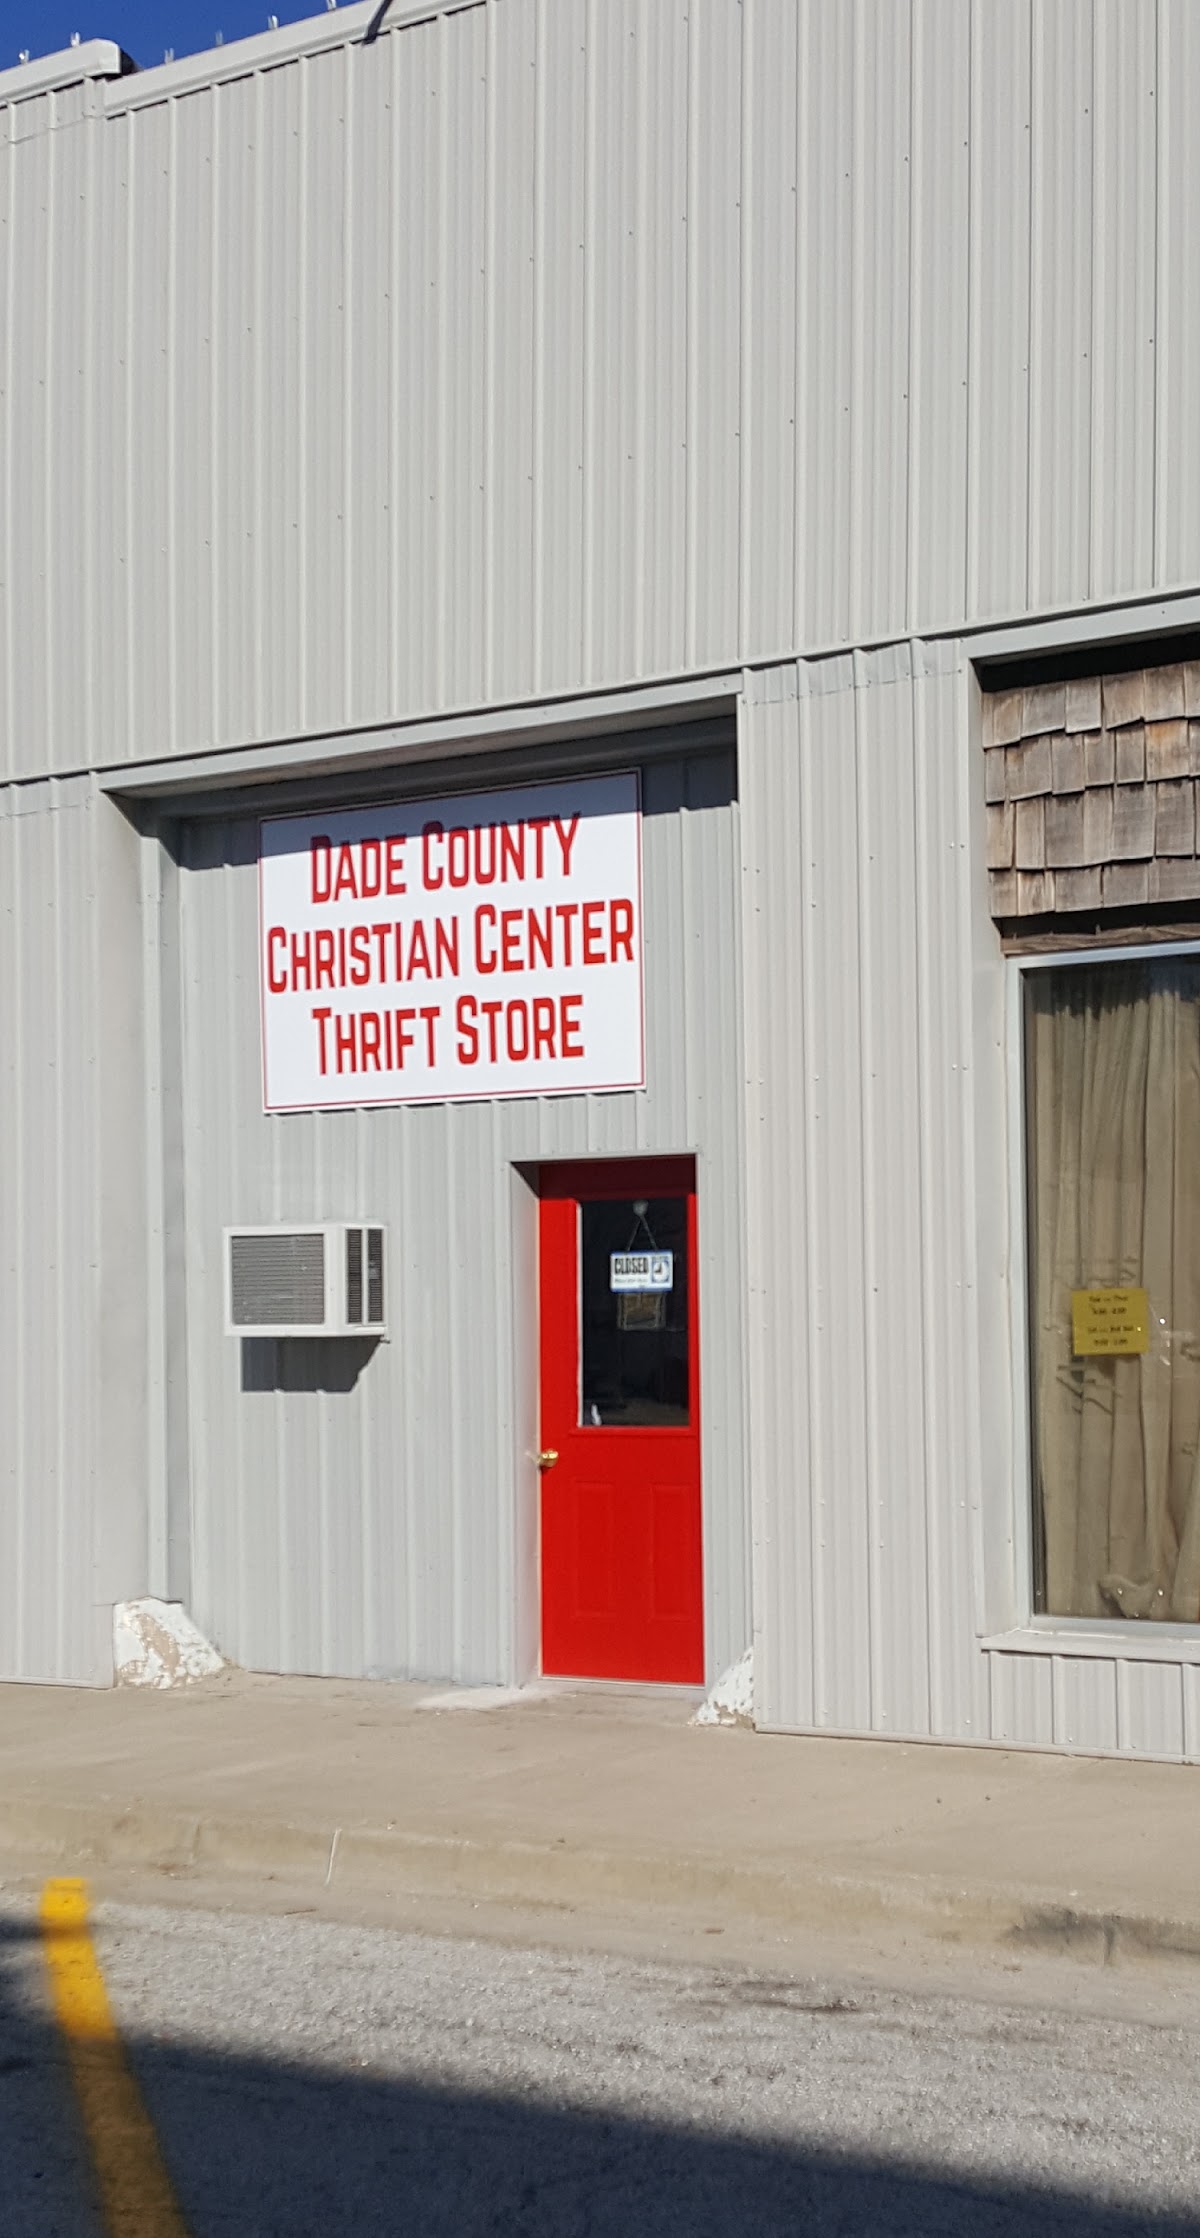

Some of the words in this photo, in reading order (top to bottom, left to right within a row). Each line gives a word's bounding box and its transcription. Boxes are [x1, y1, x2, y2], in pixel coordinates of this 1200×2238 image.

[310, 835, 407, 904] DADE
[421, 812, 581, 891] COUNTY
[267, 916, 460, 994] CHRISTIAN
[475, 899, 634, 975] CENTER
[311, 1006, 441, 1075] THRIFT
[456, 994, 584, 1066] STORE
[614, 1257, 649, 1274] CLOSED
